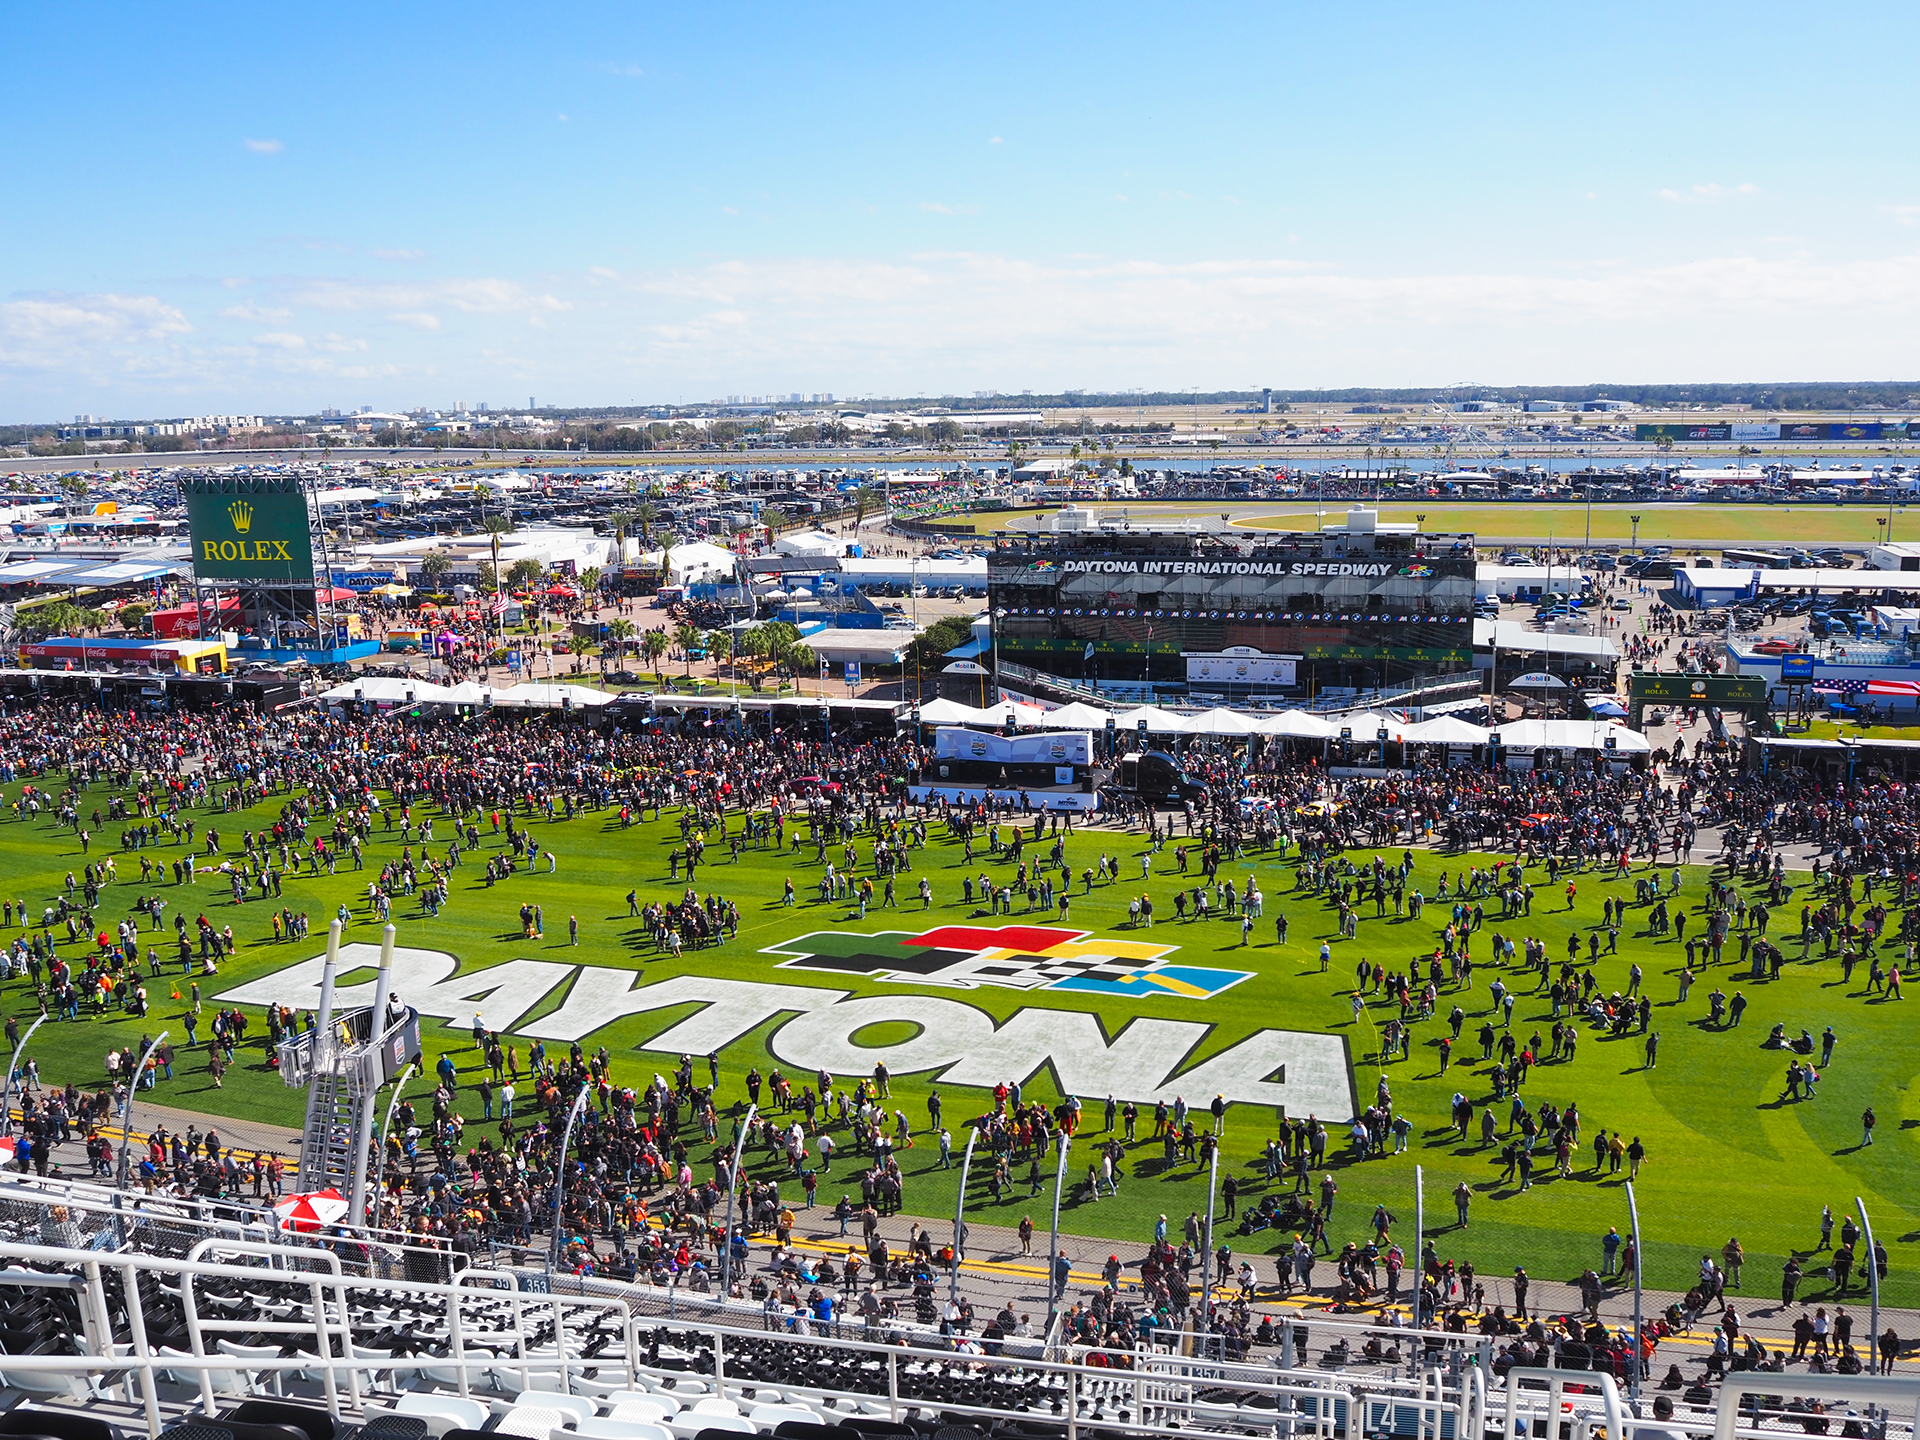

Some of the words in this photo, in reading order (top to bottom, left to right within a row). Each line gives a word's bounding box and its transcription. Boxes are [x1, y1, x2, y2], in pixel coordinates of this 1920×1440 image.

[202, 540, 292, 560] ROLEX
[1064, 560, 1138, 573] DAYTONA
[1143, 562, 1285, 574] INTERNATIONAL
[1290, 562, 1392, 576] SPEEDWAY
[349, 577, 391, 586] DAYTONA
[1008, 692, 1020, 701] Mobil
[213, 942, 1358, 1124] DAYTONA
[527, 1279, 547, 1294] 353
